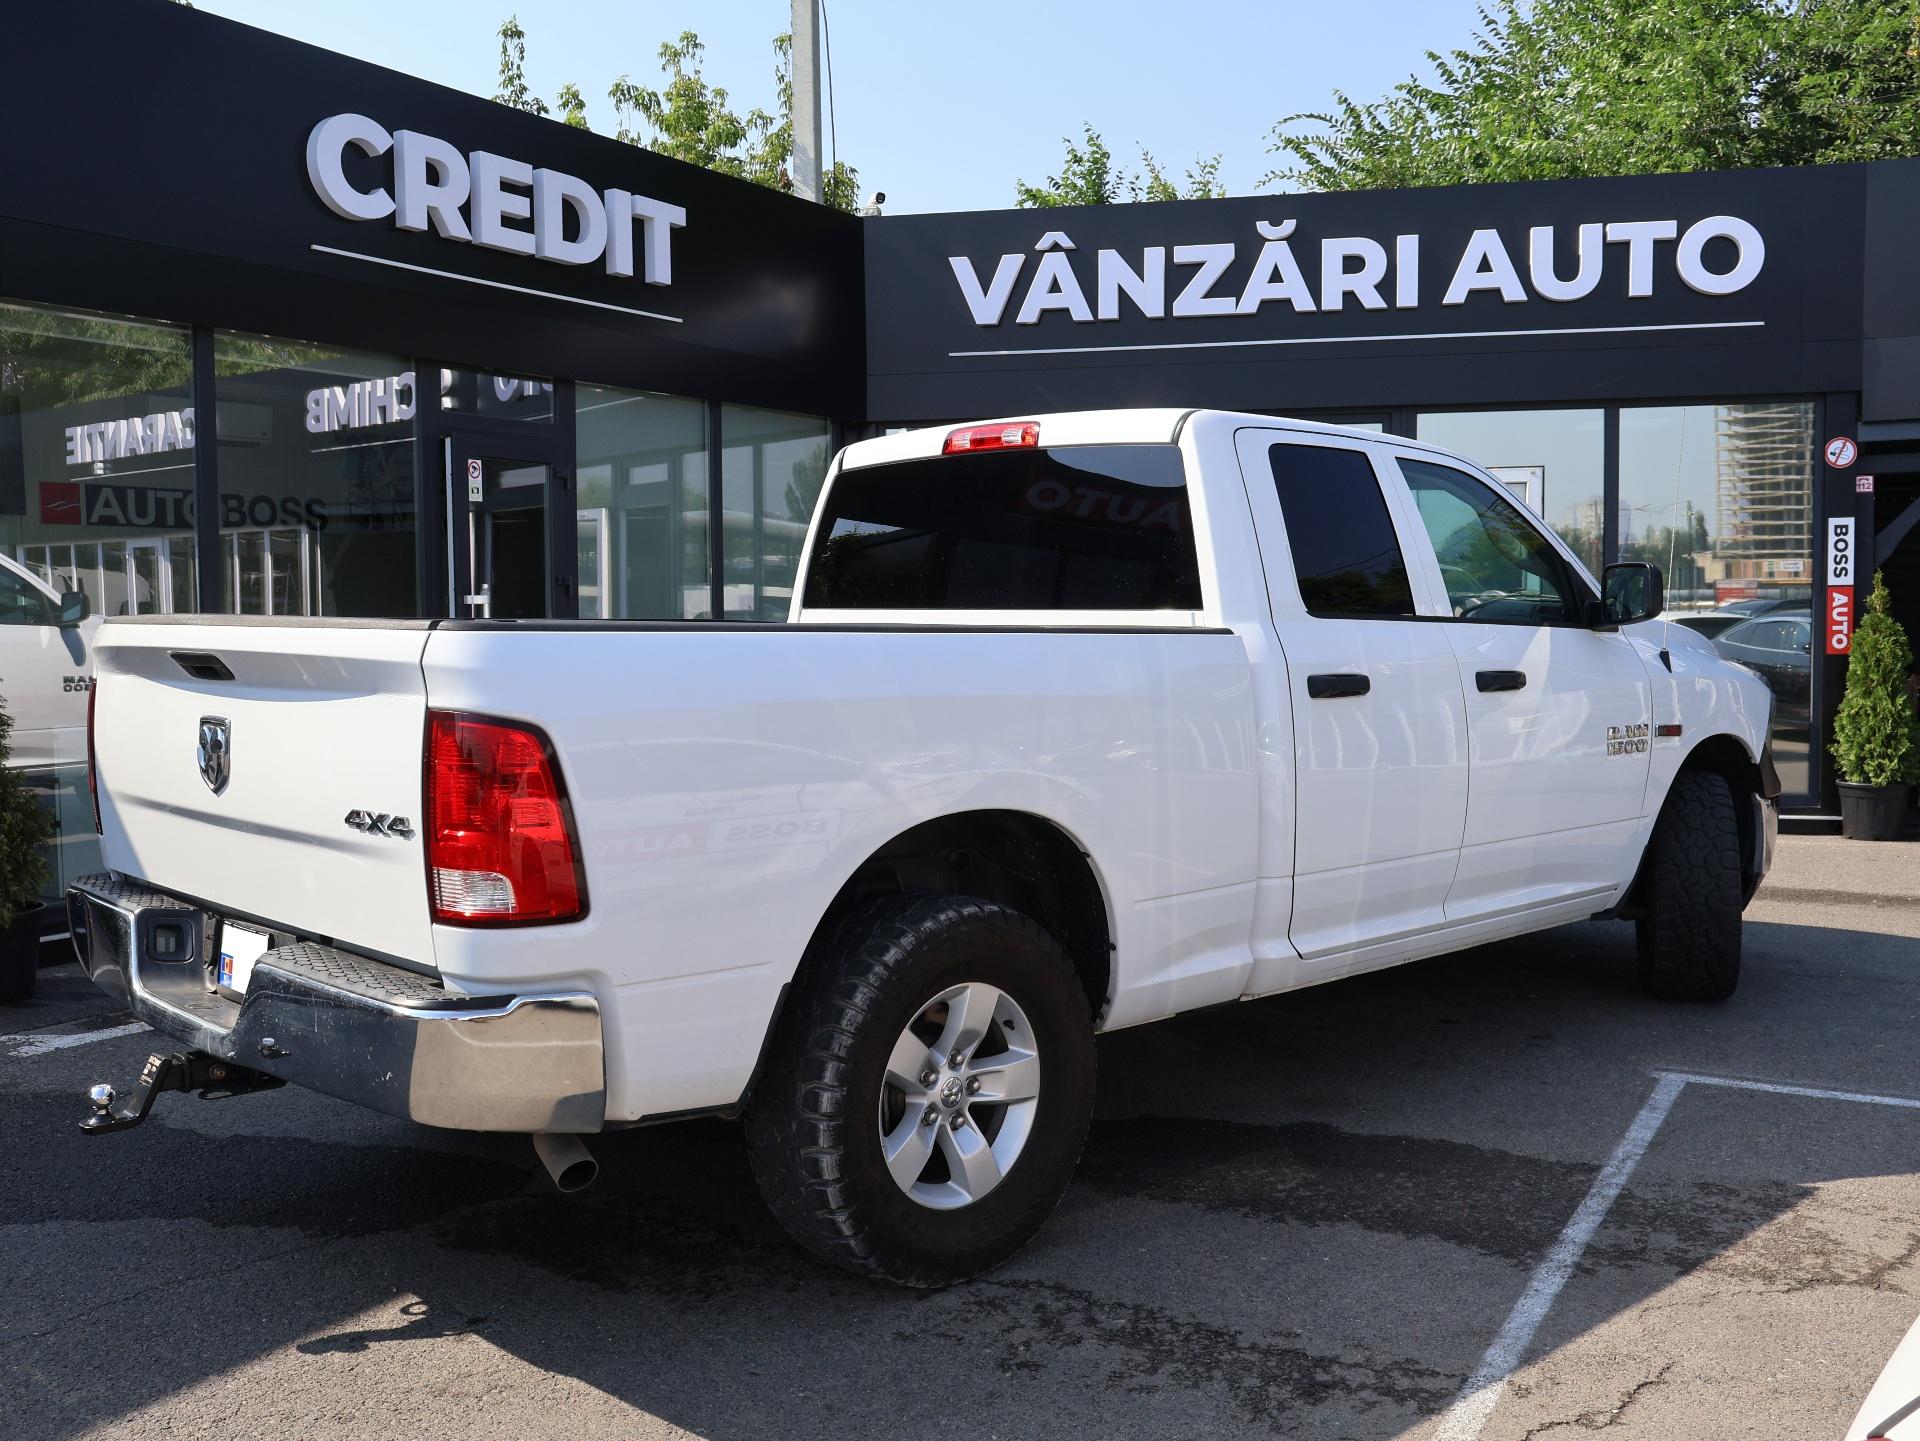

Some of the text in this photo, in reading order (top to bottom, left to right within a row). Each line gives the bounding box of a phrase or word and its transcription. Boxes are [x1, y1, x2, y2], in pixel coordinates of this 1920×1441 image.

[306, 113, 686, 286] CREDIT
[948, 215, 1766, 326] VÂNZĂRI AUTO
[1857, 482, 1871, 490] 112
[221, 493, 328, 531] BOSS
[1831, 524, 1849, 649] BOSS AUTO
[1607, 724, 1649, 740] RAM
[1607, 739, 1649, 757] 1500
